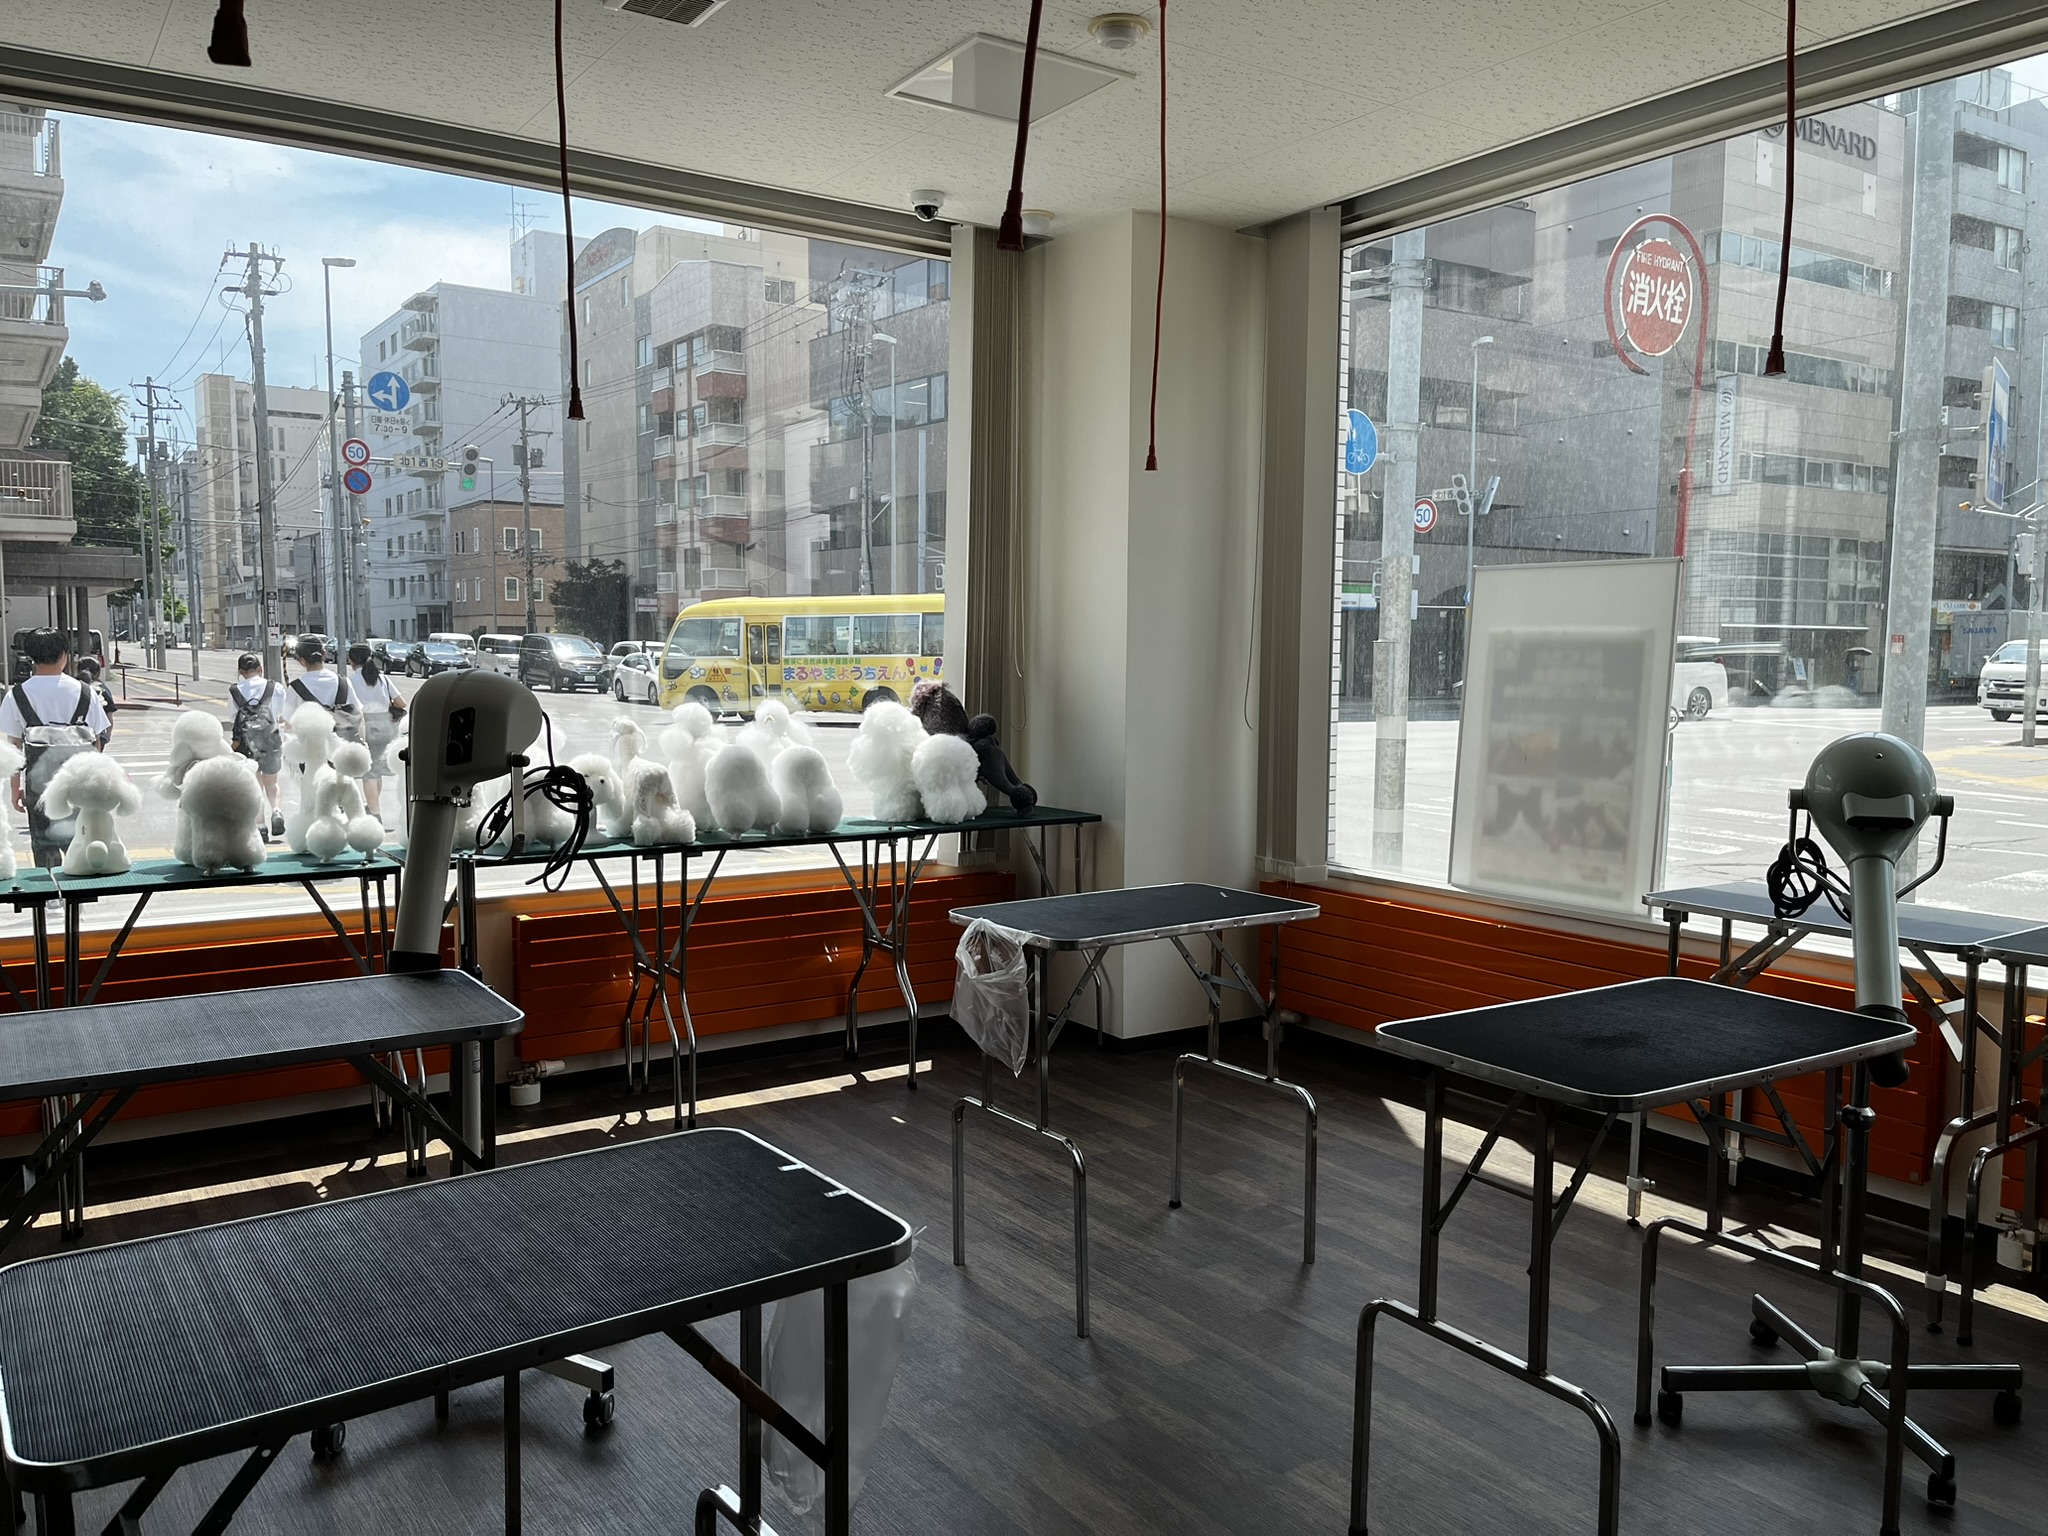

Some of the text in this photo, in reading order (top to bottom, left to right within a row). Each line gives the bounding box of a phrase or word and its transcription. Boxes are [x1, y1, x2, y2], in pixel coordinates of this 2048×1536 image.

[1636, 250, 1684, 273] FIRE HYDRANT
[1627, 270, 1687, 325] 消火栓
[347, 446, 364, 459] 50
[1718, 411, 1731, 484] MENARD
[1415, 508, 1431, 523] 50
[783, 667, 907, 681] まるやまようちえん
